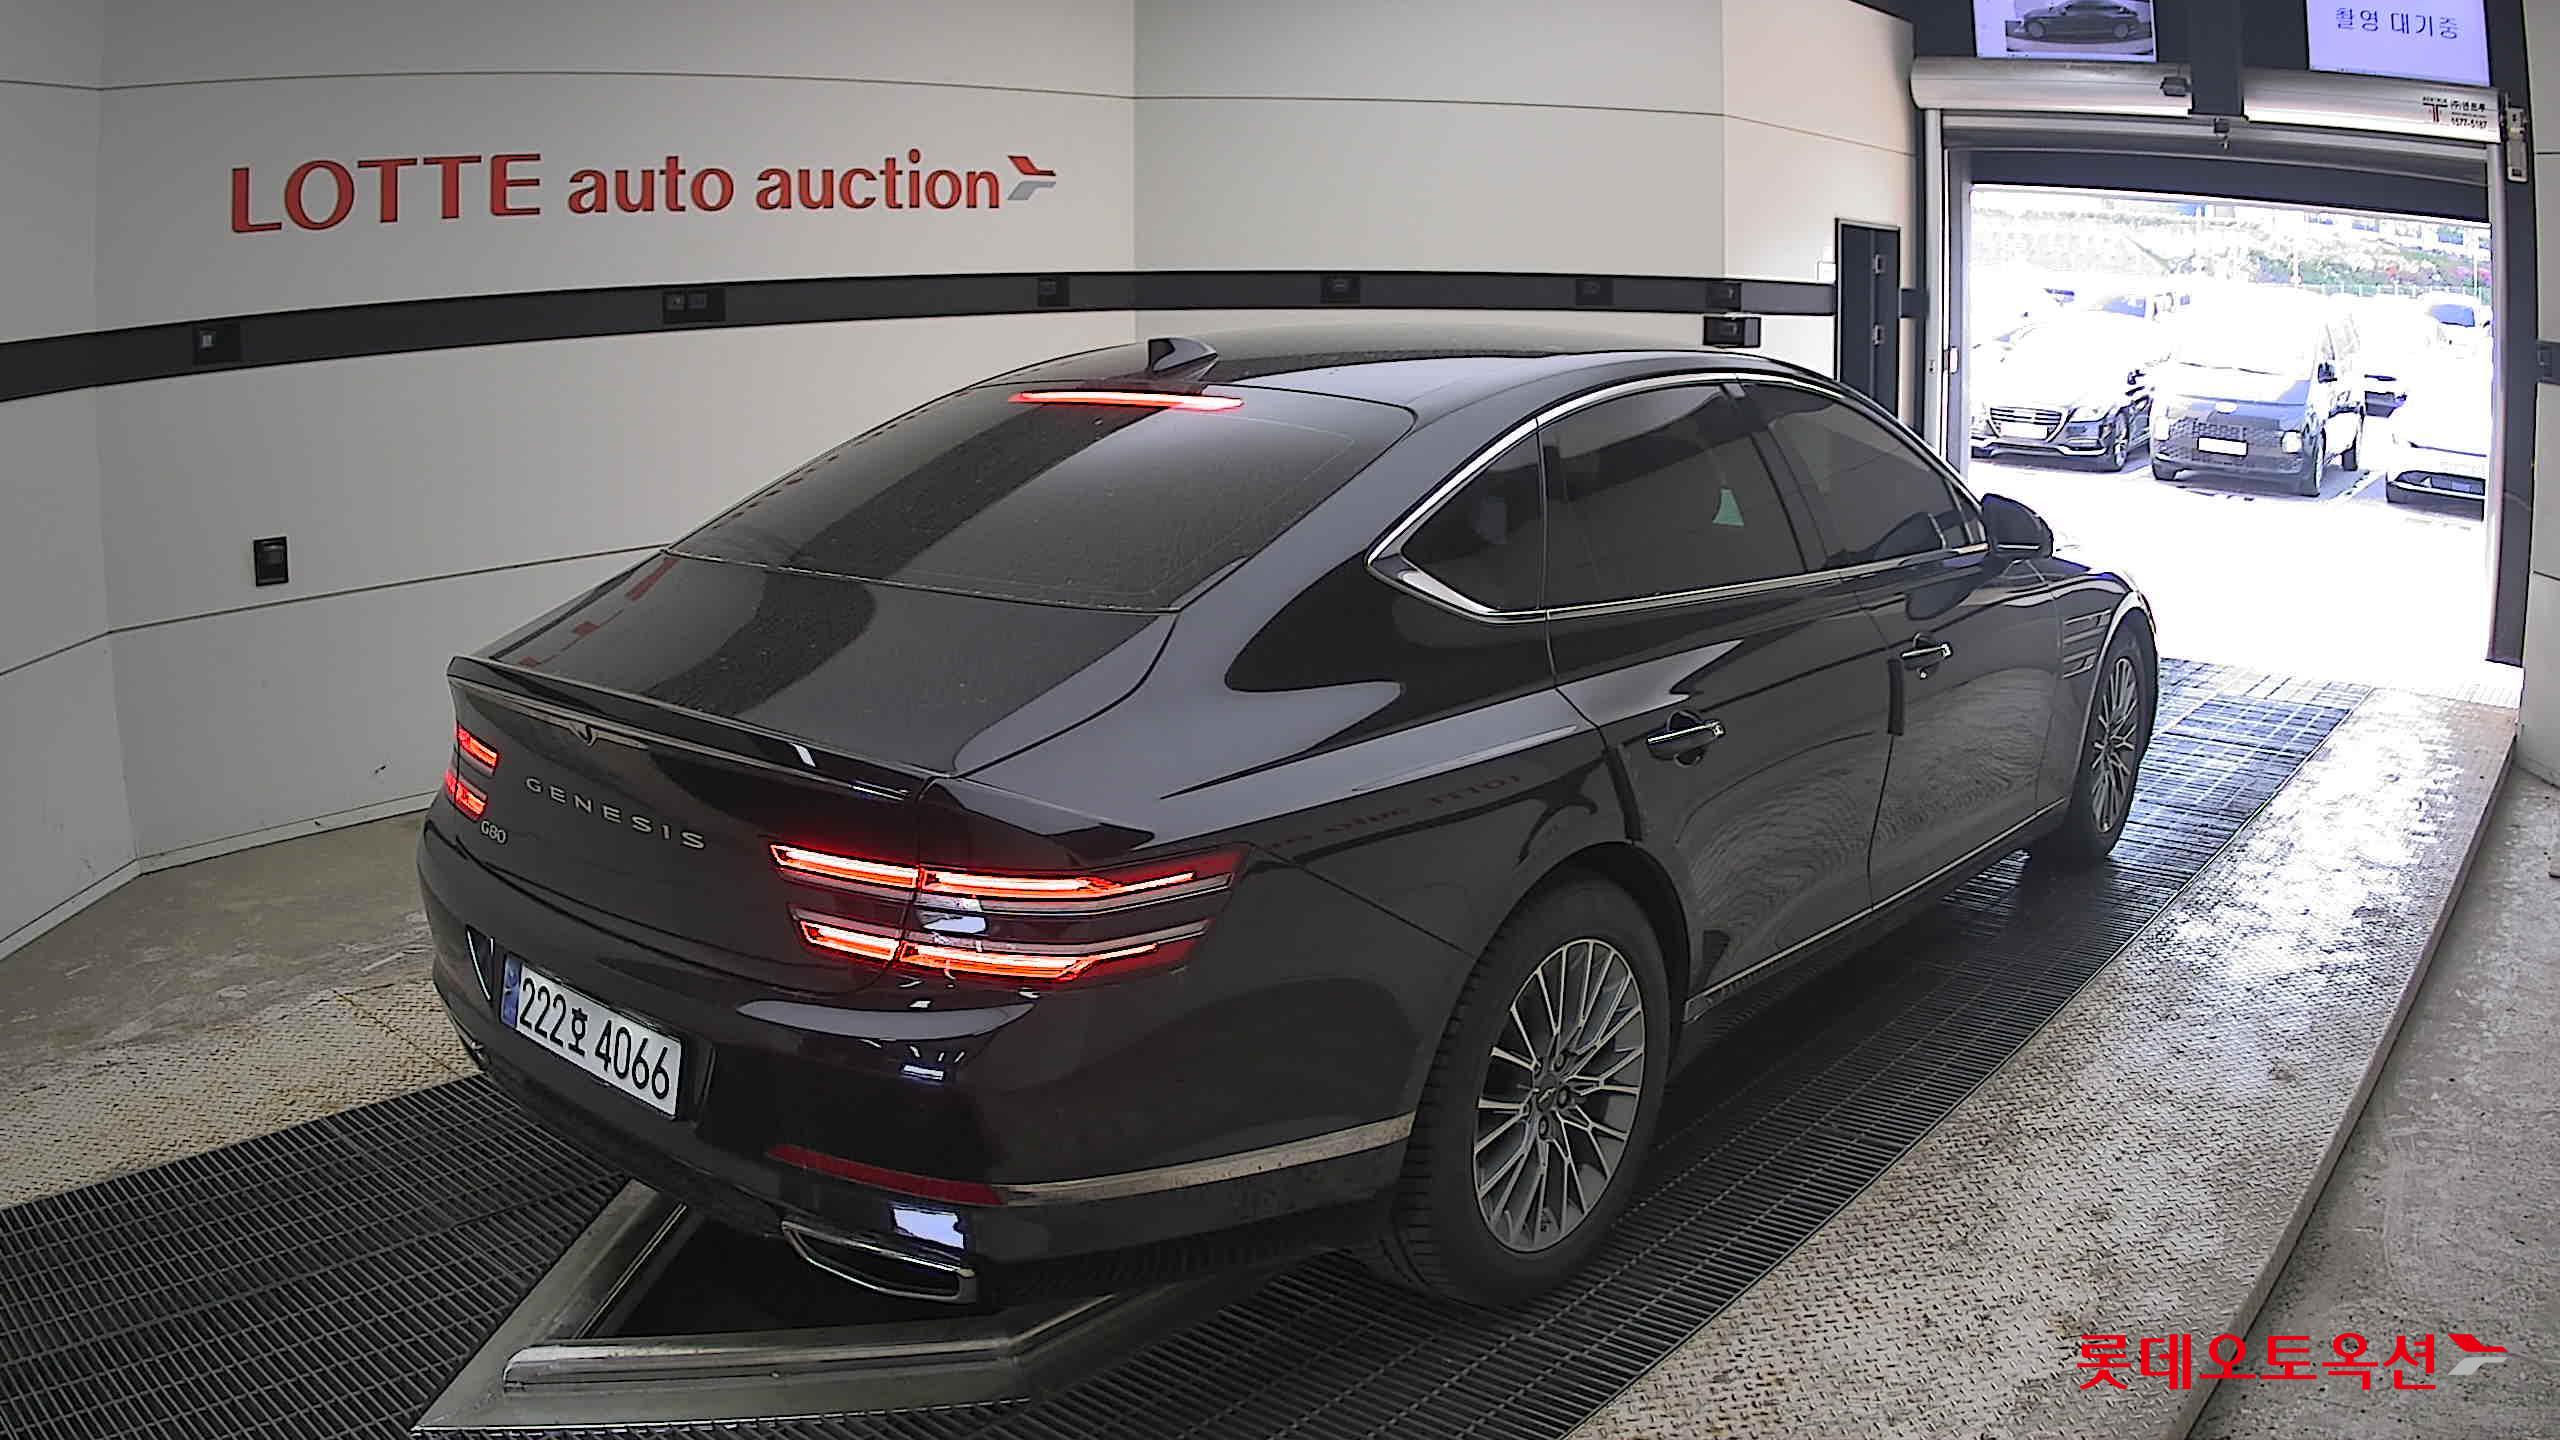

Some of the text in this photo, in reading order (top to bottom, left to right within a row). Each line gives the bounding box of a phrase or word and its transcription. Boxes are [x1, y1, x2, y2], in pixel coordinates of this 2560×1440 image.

[2336, 7, 2458, 40] 촬영 대기중
[231, 149, 1001, 234] LOTTE auto auction
[480, 819, 508, 845] G80
[525, 776, 706, 850] GENESIS
[518, 976, 671, 1100] 222호 4066
